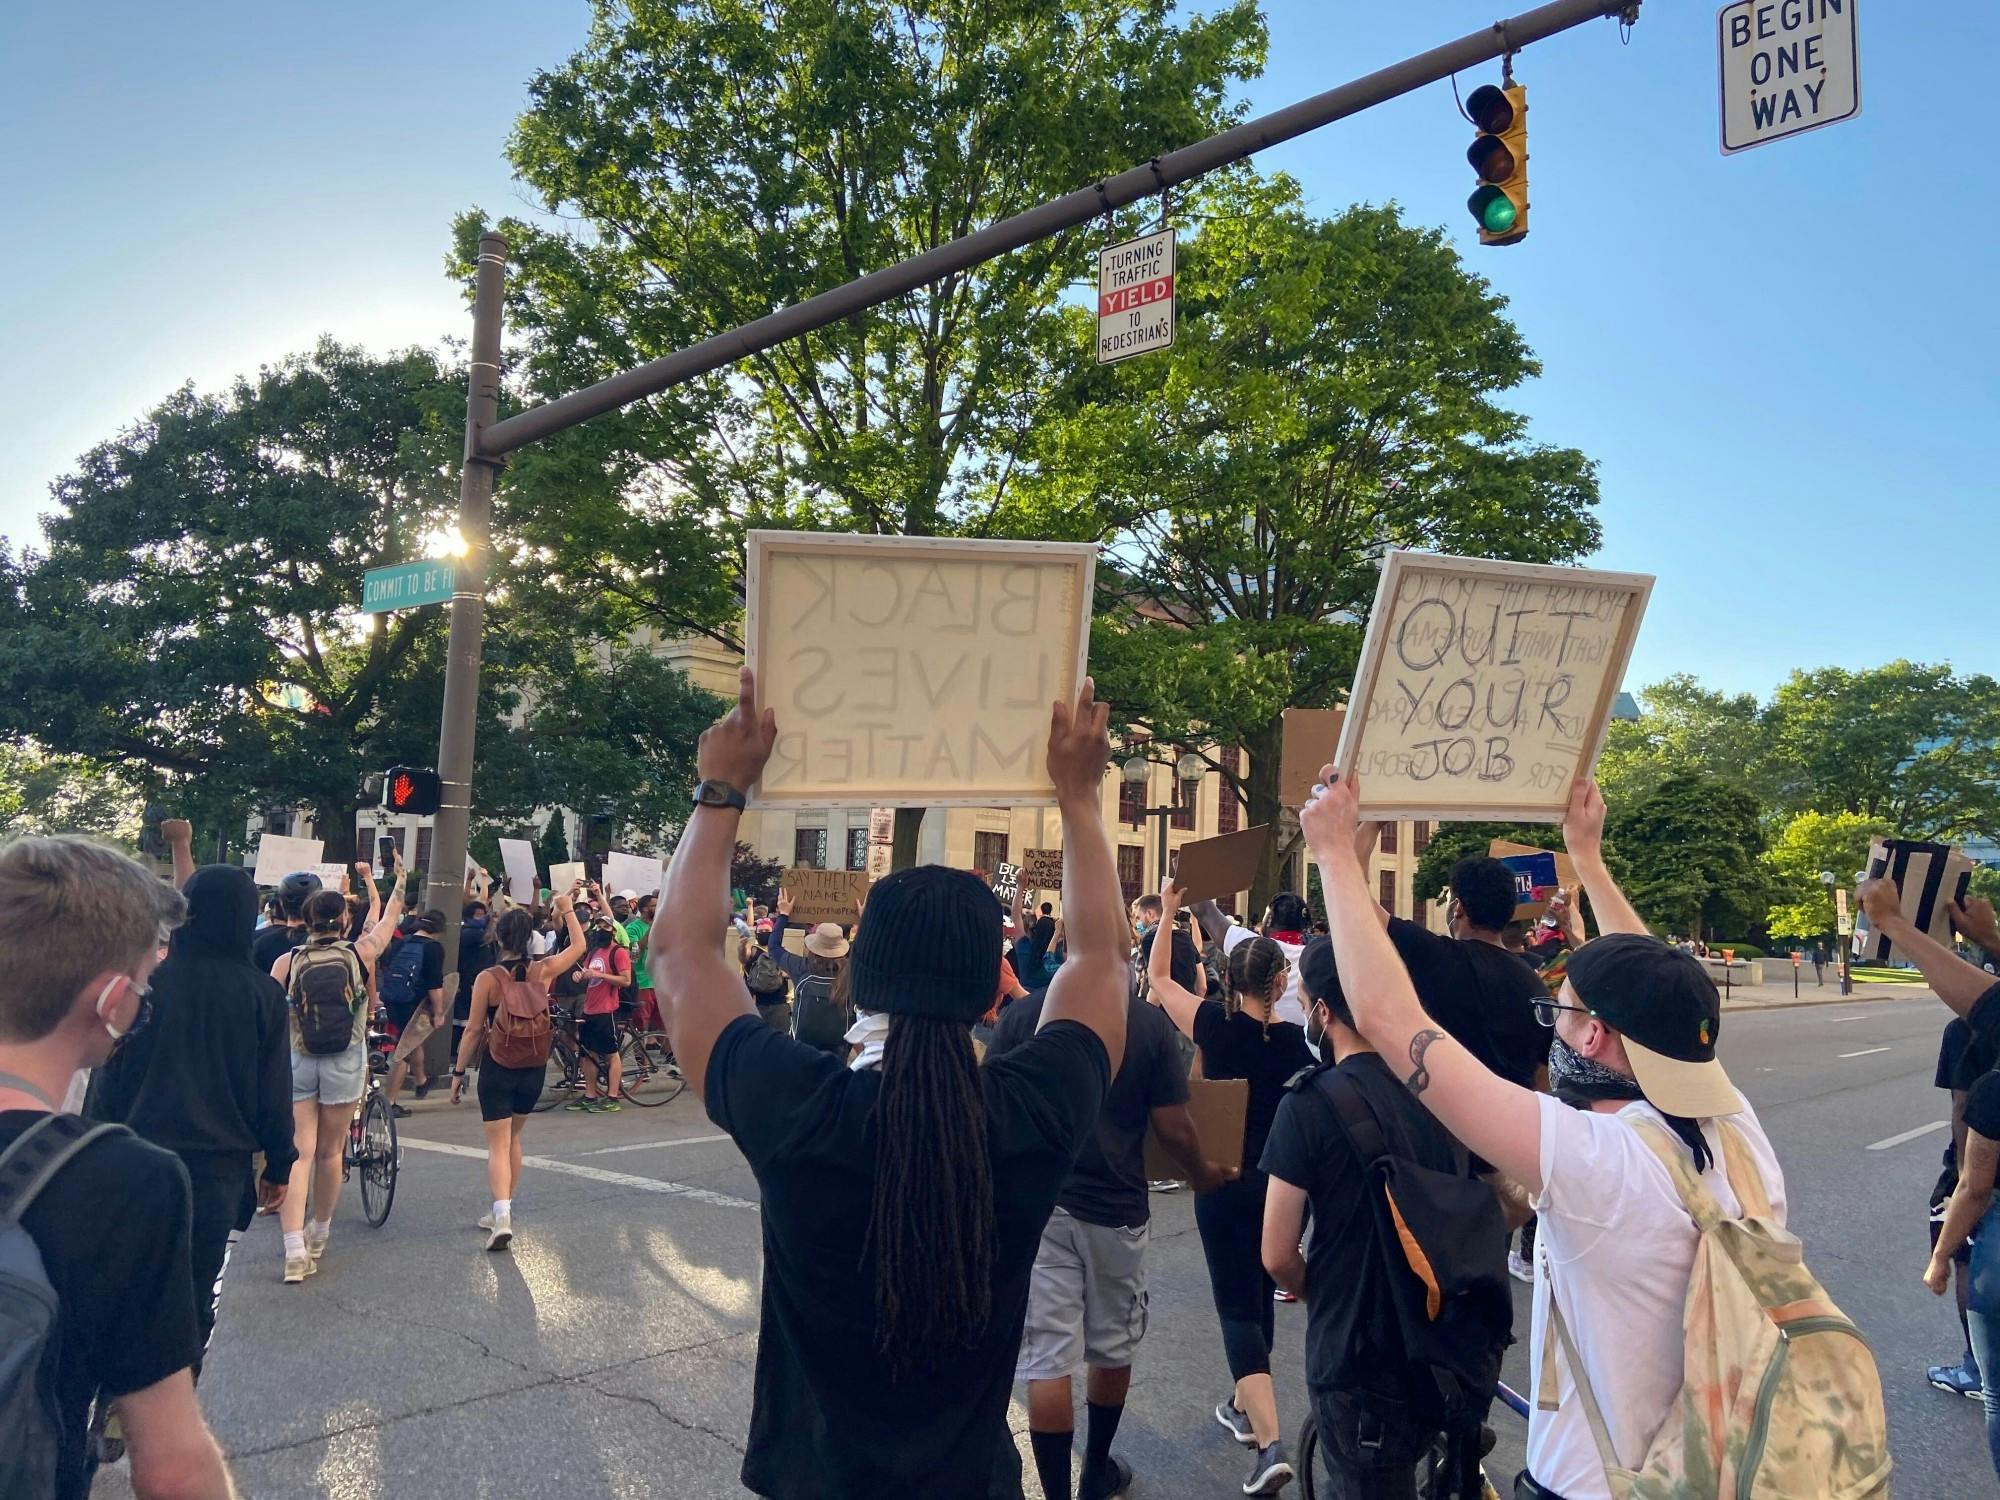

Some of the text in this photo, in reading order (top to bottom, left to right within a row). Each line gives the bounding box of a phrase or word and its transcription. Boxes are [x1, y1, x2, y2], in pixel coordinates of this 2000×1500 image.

[1731, 0, 1842, 48] BEGIN
[1750, 34, 1825, 86] ONE
[1750, 79, 1826, 131] WAY
[1110, 241, 1163, 270] TURNING
[1112, 260, 1160, 288] TRAFFIC
[1105, 281, 1167, 312] YIELD
[1129, 311, 1141, 328] TO
[1101, 321, 1169, 354] PEDESTRIANS
[366, 576, 404, 602] COMMIT
[407, 573, 419, 596] TO
[424, 570, 438, 592] BE
[1396, 598, 1598, 672] QUIT
[1396, 676, 1572, 734] YOUR
[1406, 736, 1515, 782] JOB
[787, 870, 861, 892] SAY THEIR
[802, 888, 849, 903] NAMES
